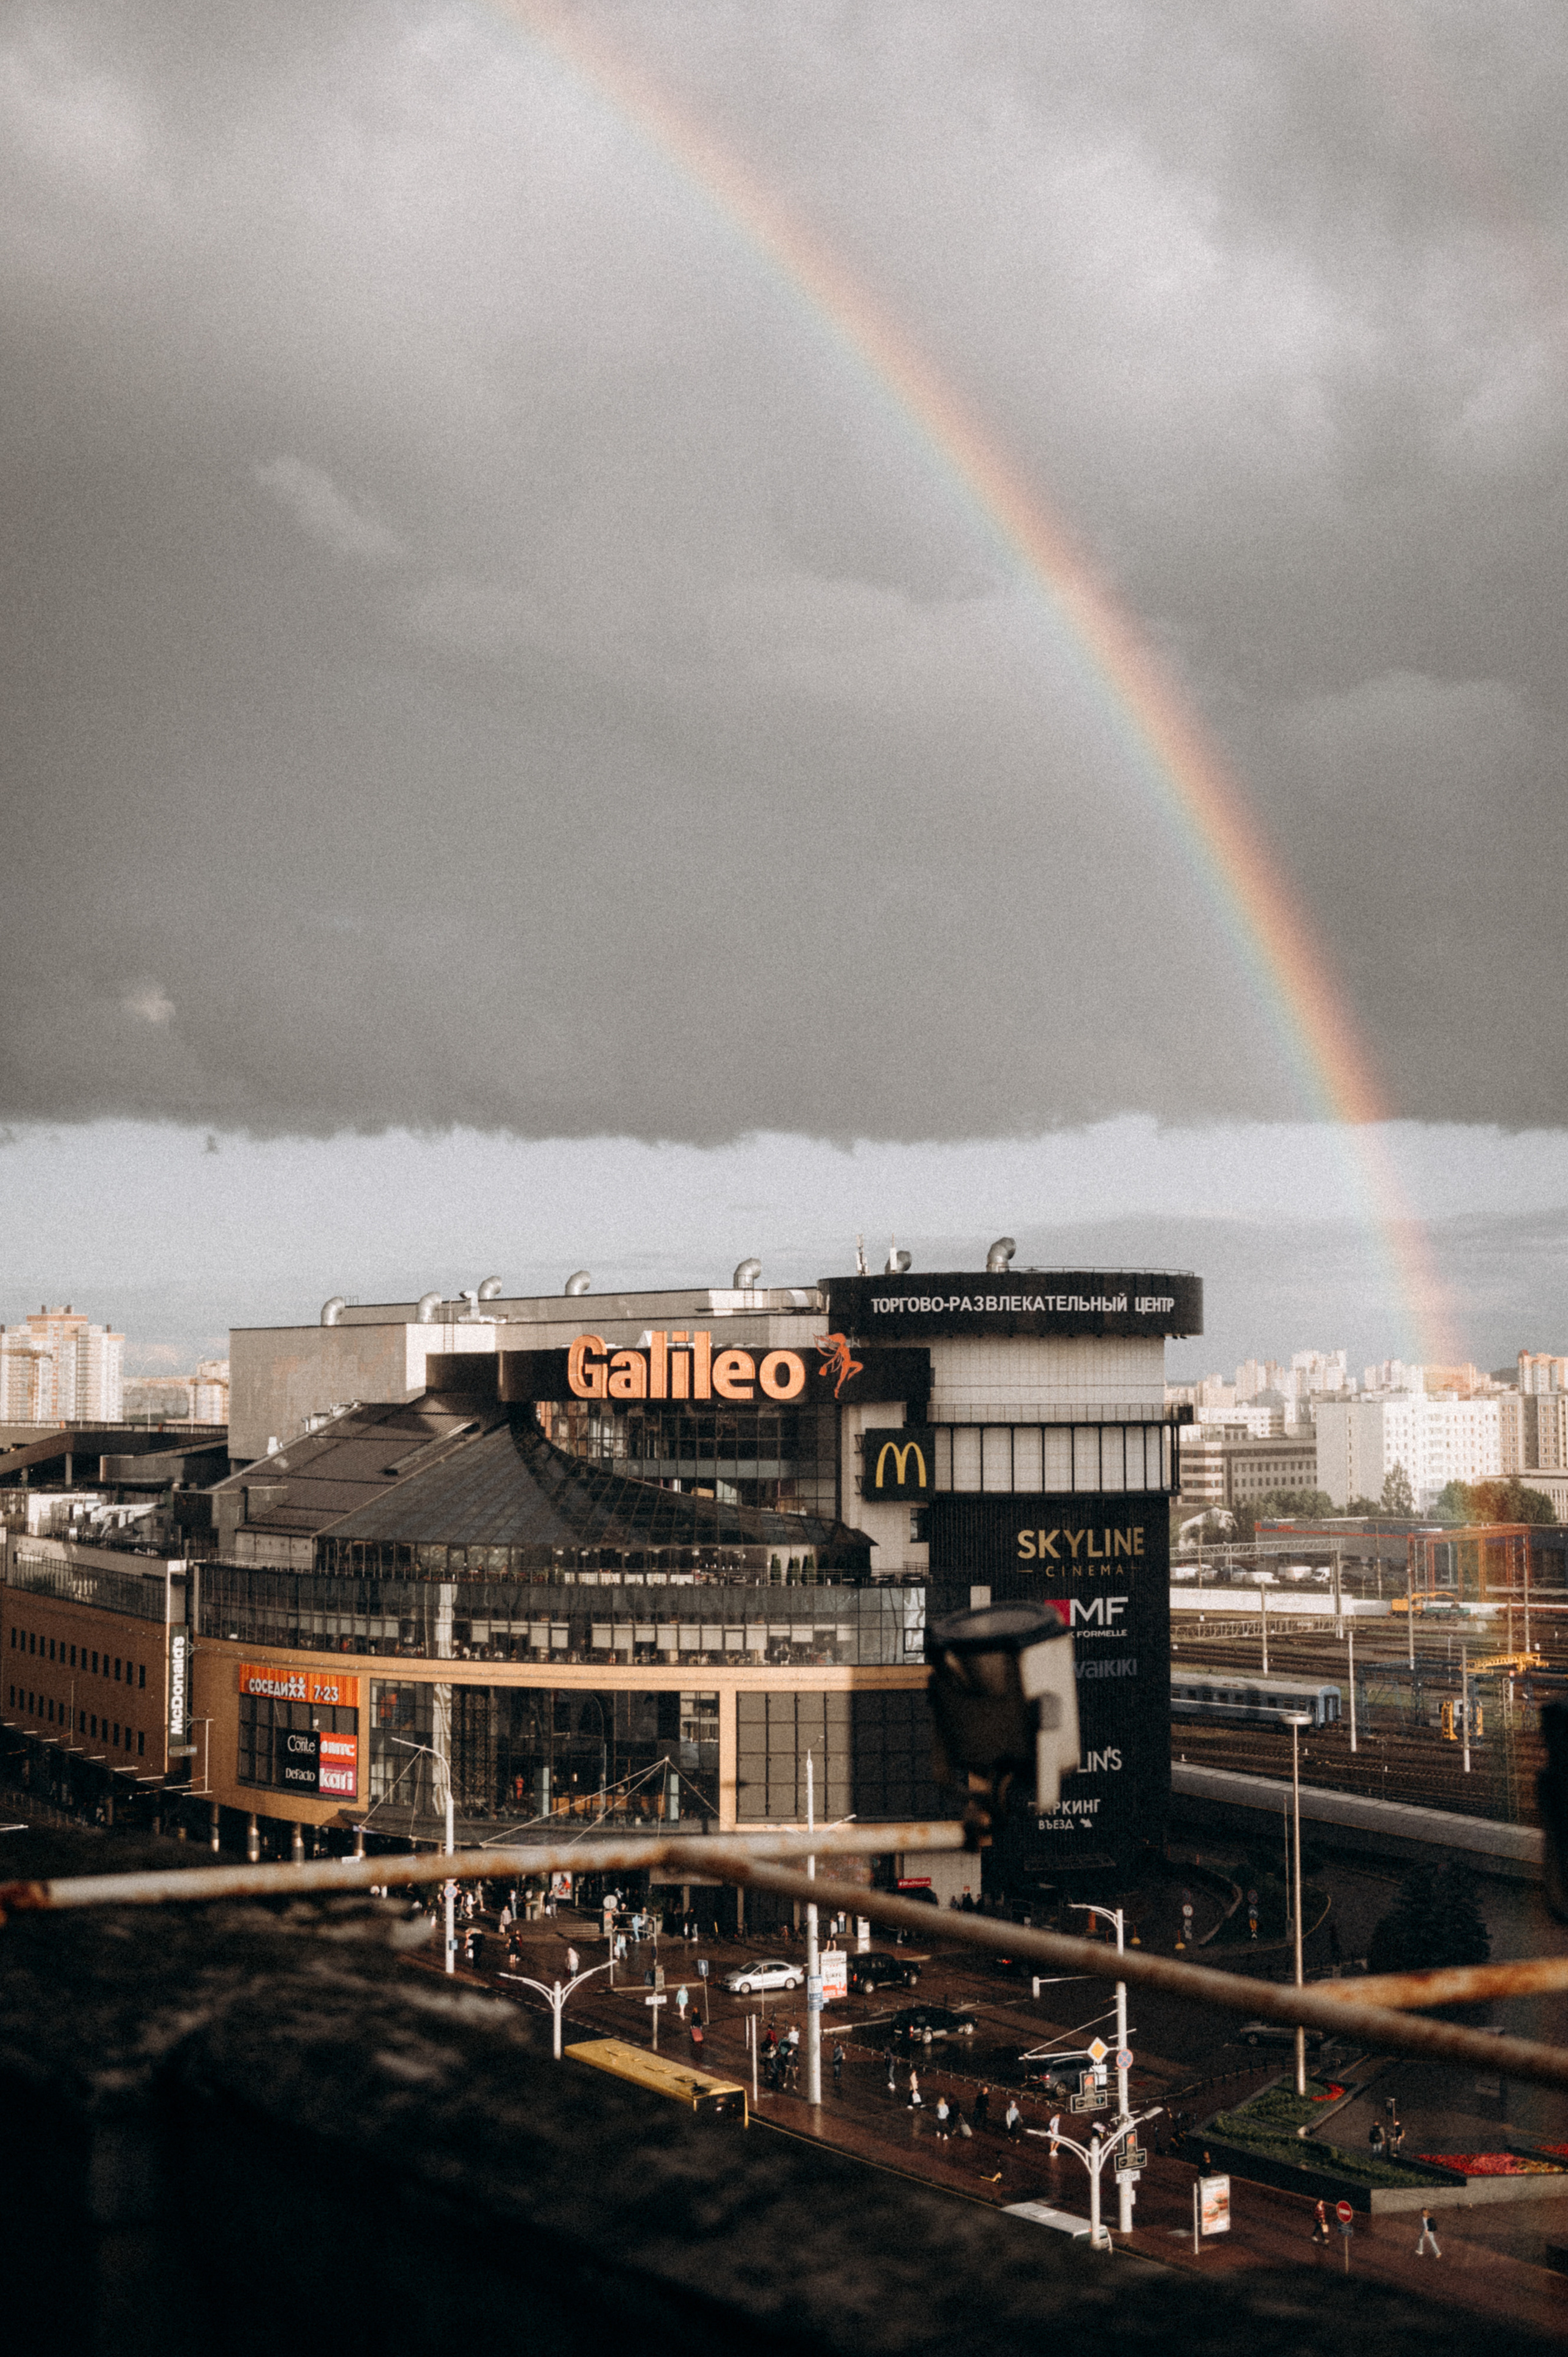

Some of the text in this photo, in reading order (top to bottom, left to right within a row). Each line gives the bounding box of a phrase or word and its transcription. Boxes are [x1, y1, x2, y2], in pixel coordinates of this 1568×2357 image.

[870, 1292, 1175, 1315] ТОРГОВО-РАЗВЛЕКАТЕЛЬНЫЙ ЦЕНТР
[567, 1330, 806, 1400] Galileo
[1017, 1527, 1144, 1559] SKYLINE
[1046, 1564, 1124, 1577] CINEMA
[1069, 1596, 1129, 1626] MF
[1076, 1629, 1128, 1639] FORMELLE
[170, 1635, 185, 1735] McDonald's
[249, 1678, 288, 1697] СОСЕДИ
[287, 1735, 316, 1752] Conte
[1077, 1746, 1122, 1773] LIN'S
[285, 1767, 315, 1782] DeFacto
[320, 1767, 353, 1790] kari
[1028, 1798, 1101, 1816] РКИНГ
[1038, 1819, 1074, 1830] ВЪЕЗД
